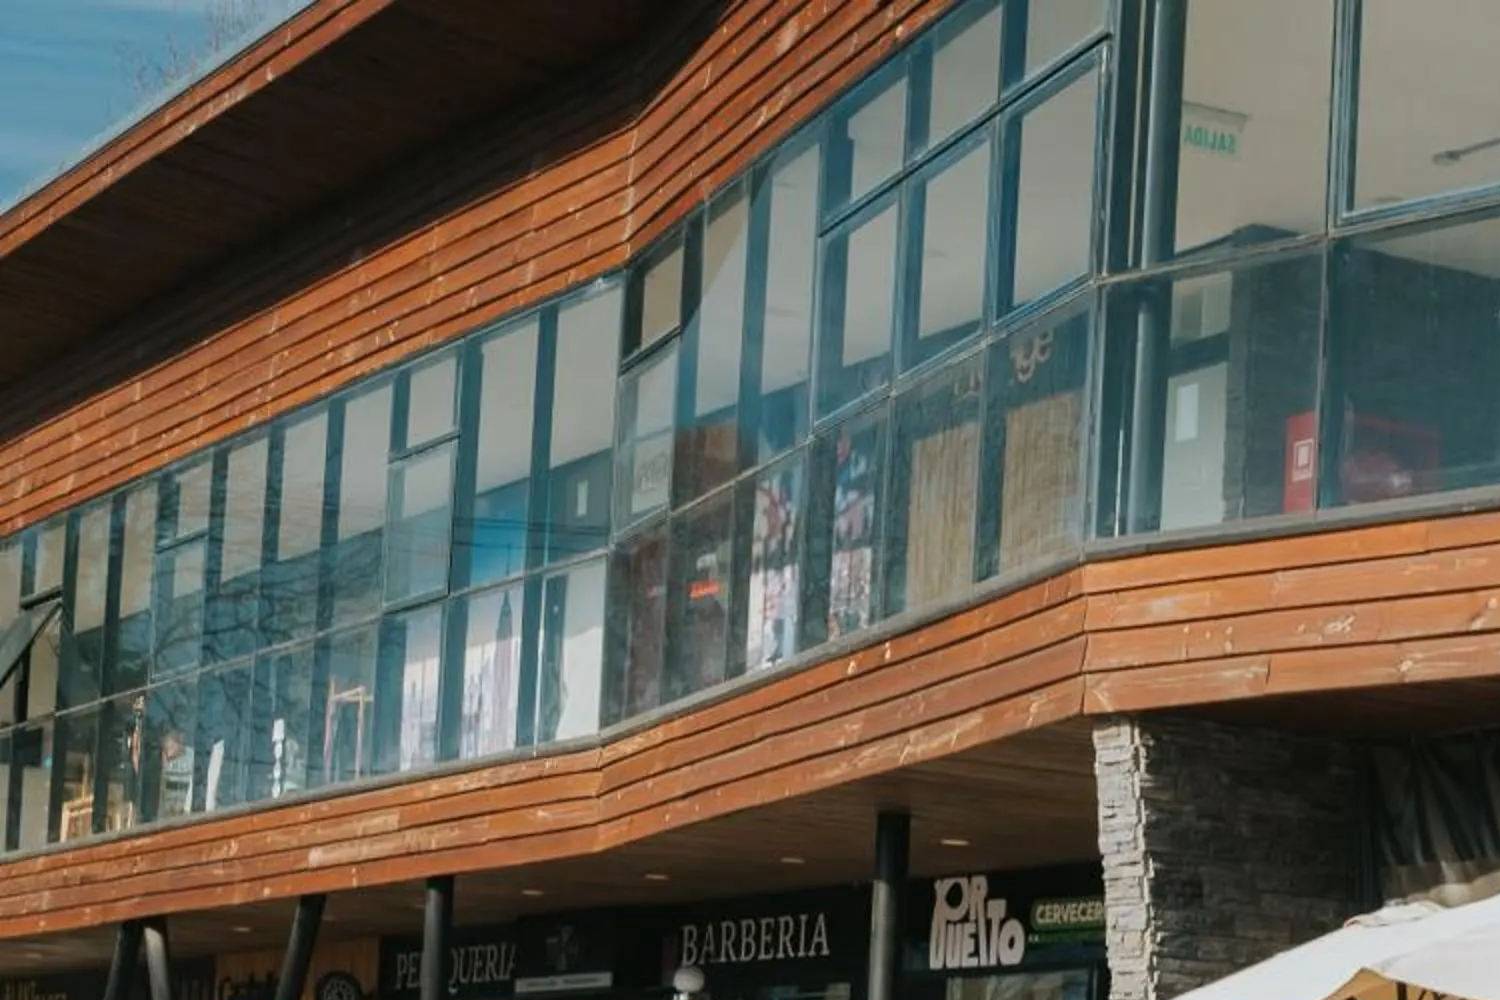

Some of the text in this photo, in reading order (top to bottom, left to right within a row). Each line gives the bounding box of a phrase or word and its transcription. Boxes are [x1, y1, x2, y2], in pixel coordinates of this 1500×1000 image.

[681, 911, 830, 966] BARBERIA
[1035, 899, 1104, 925] CERVECER
[395, 942, 517, 995] PEQUERI
